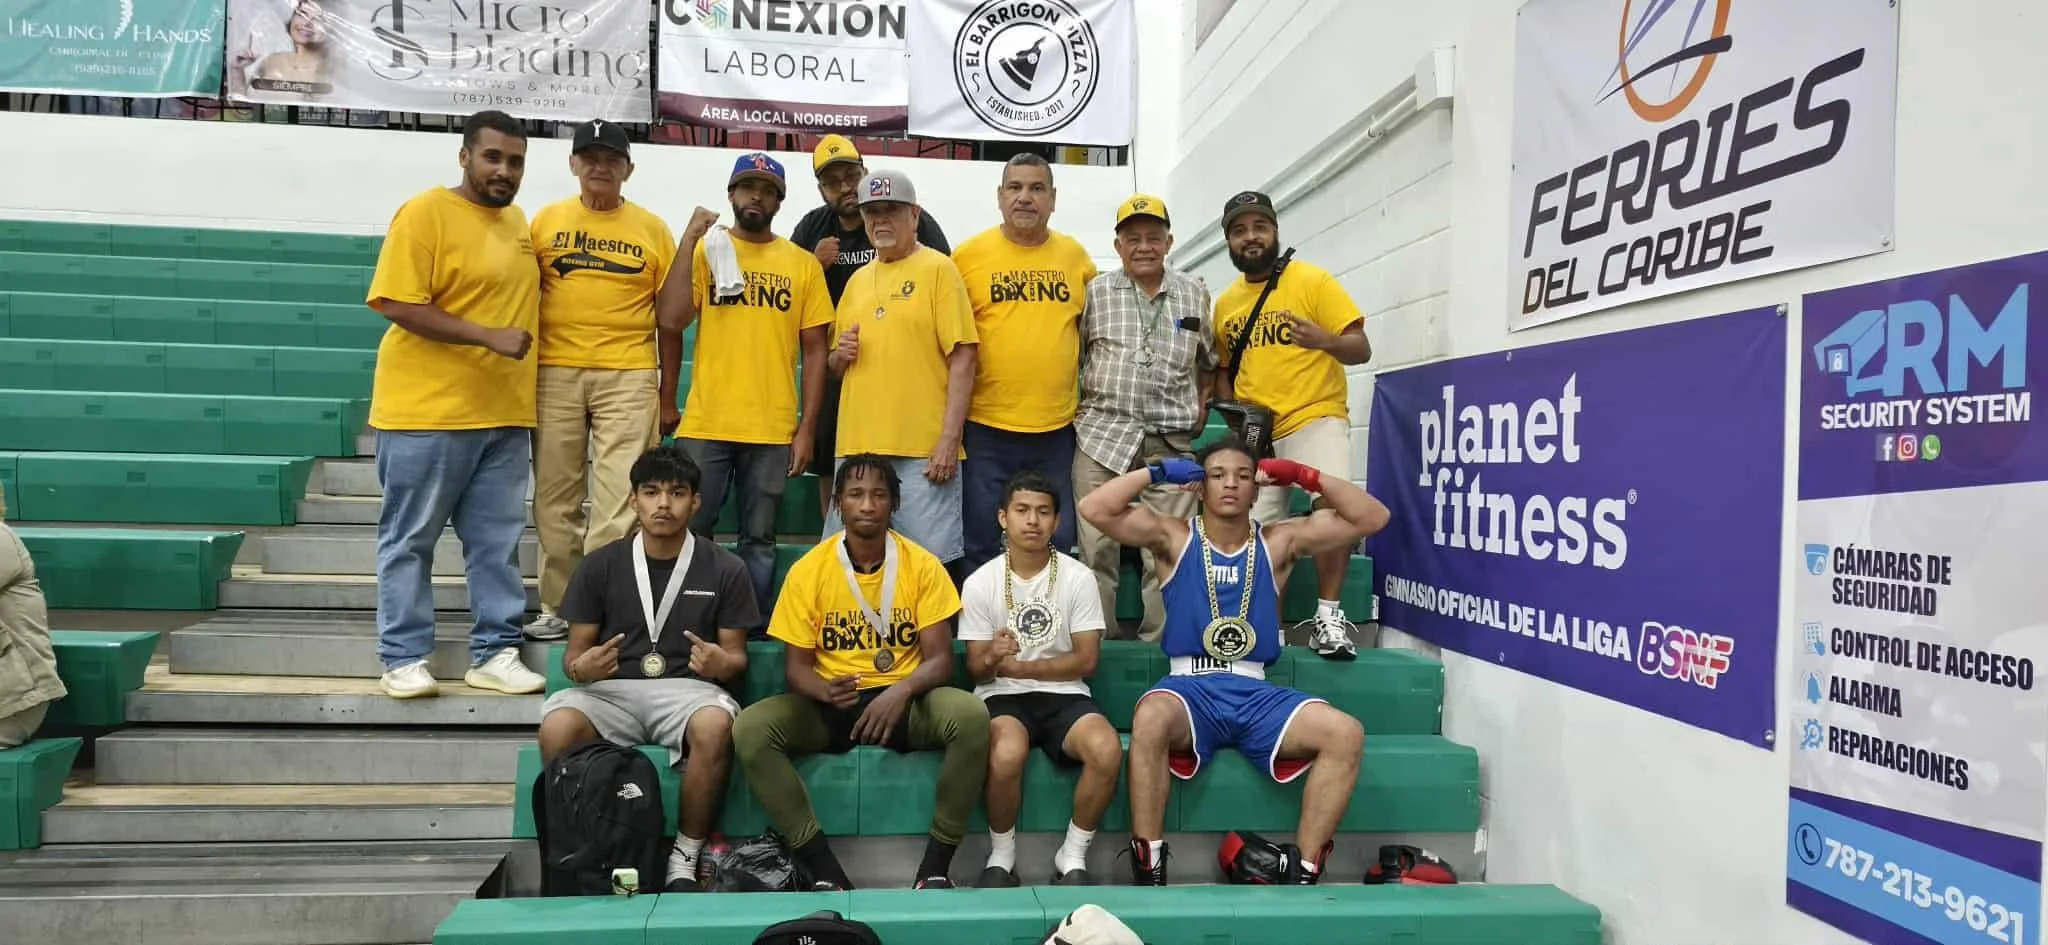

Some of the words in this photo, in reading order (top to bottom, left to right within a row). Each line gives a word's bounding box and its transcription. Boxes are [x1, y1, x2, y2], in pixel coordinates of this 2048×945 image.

[8, 17, 104, 41] HEALING
[133, 24, 212, 43] HANDS
[704, 48, 865, 82] LABORAL
[966, 50, 980, 67] EL
[1064, 26, 1088, 75] IZZA
[527, 82, 537, 92] &
[550, 83, 601, 96] MORE
[1046, 99, 1065, 117] 2017
[701, 104, 739, 121] ÁREA
[744, 109, 789, 124] LOCAL
[793, 111, 868, 127] NOROESTE
[1524, 48, 1865, 258] FERRIES
[870, 178, 891, 196] 21
[552, 232, 570, 249] El
[574, 231, 643, 257] Maestro
[1522, 259, 1588, 315] DEL
[1597, 200, 1775, 296] CARIBE
[742, 271, 791, 289] AESTRO
[1009, 270, 1066, 282] MAESTRO
[709, 284, 792, 312] BXING
[1239, 310, 1290, 328] MESTRO
[1419, 372, 1582, 487] planet
[1820, 399, 1922, 430] SECURITY
[1926, 391, 2031, 426] SYSTEM
[1433, 467, 1628, 570] fitness
[1832, 542, 1923, 585] CÁMARAS
[1927, 554, 1952, 586] DE
[1832, 577, 1937, 617] SEGURIDAD
[825, 611, 841, 626] EL
[1385, 573, 1435, 611] GIMNASIO
[1438, 588, 1506, 629] OFICIAL
[1508, 606, 1536, 638] DE
[1538, 616, 1569, 646] LA
[1572, 620, 1632, 662] LIGA
[1830, 627, 1913, 668] CONTROL
[1917, 642, 1942, 674] DE
[1945, 646, 2034, 691] ACCESO
[1828, 675, 1903, 718] ALARMA
[1827, 725, 1969, 791] REPARACIONES
[1825, 838, 2024, 945] 787-213-9621
